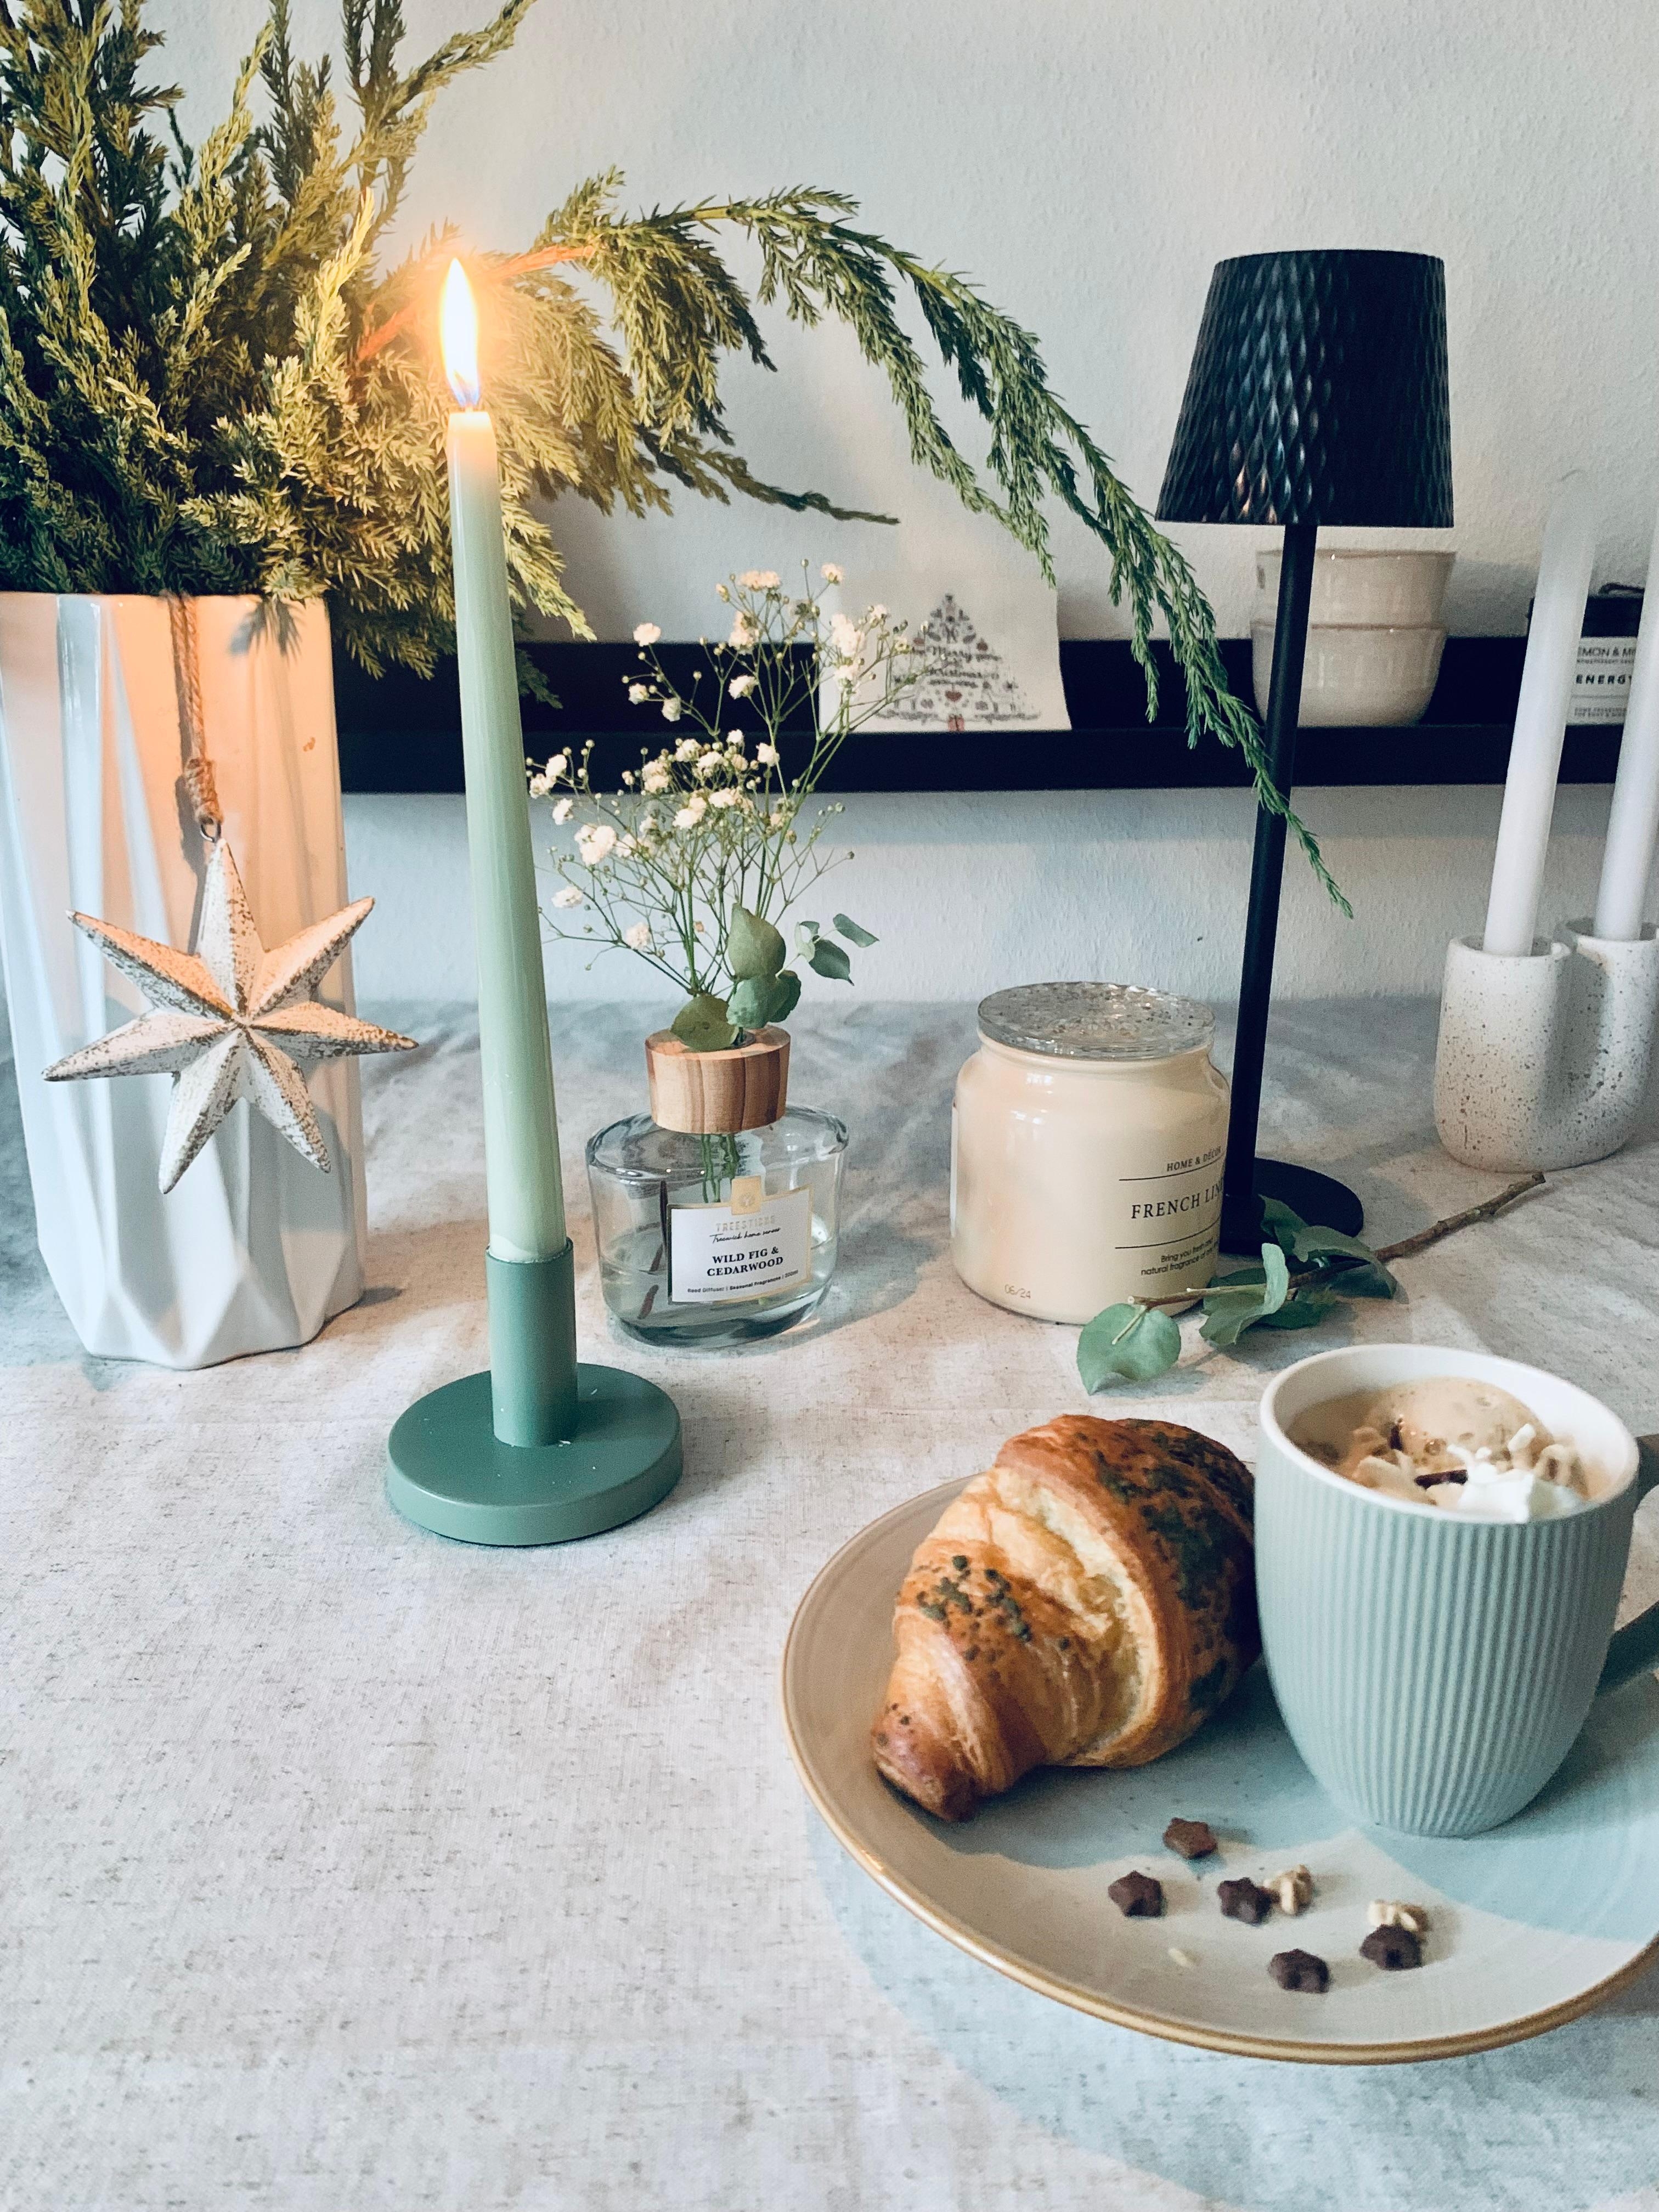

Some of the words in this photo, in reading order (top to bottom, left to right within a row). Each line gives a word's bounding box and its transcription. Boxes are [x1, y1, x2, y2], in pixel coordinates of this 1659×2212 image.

[1167, 1158, 1193, 1171] HOME
[1195, 1156, 1200, 1165] &
[1131, 1193, 1200, 1219] FRENCH
[712, 1253, 745, 1263] WILD
[748, 1249, 768, 1260] FIG
[771, 1246, 779, 1255] &
[1161, 1254, 1178, 1262] Bring
[707, 1257, 783, 1277] CEDARWOOD
[1141, 1265, 1169, 1276] natural
[1170, 1255, 1199, 1271] fragrance
[730, 1282, 753, 1290] Seasonal
